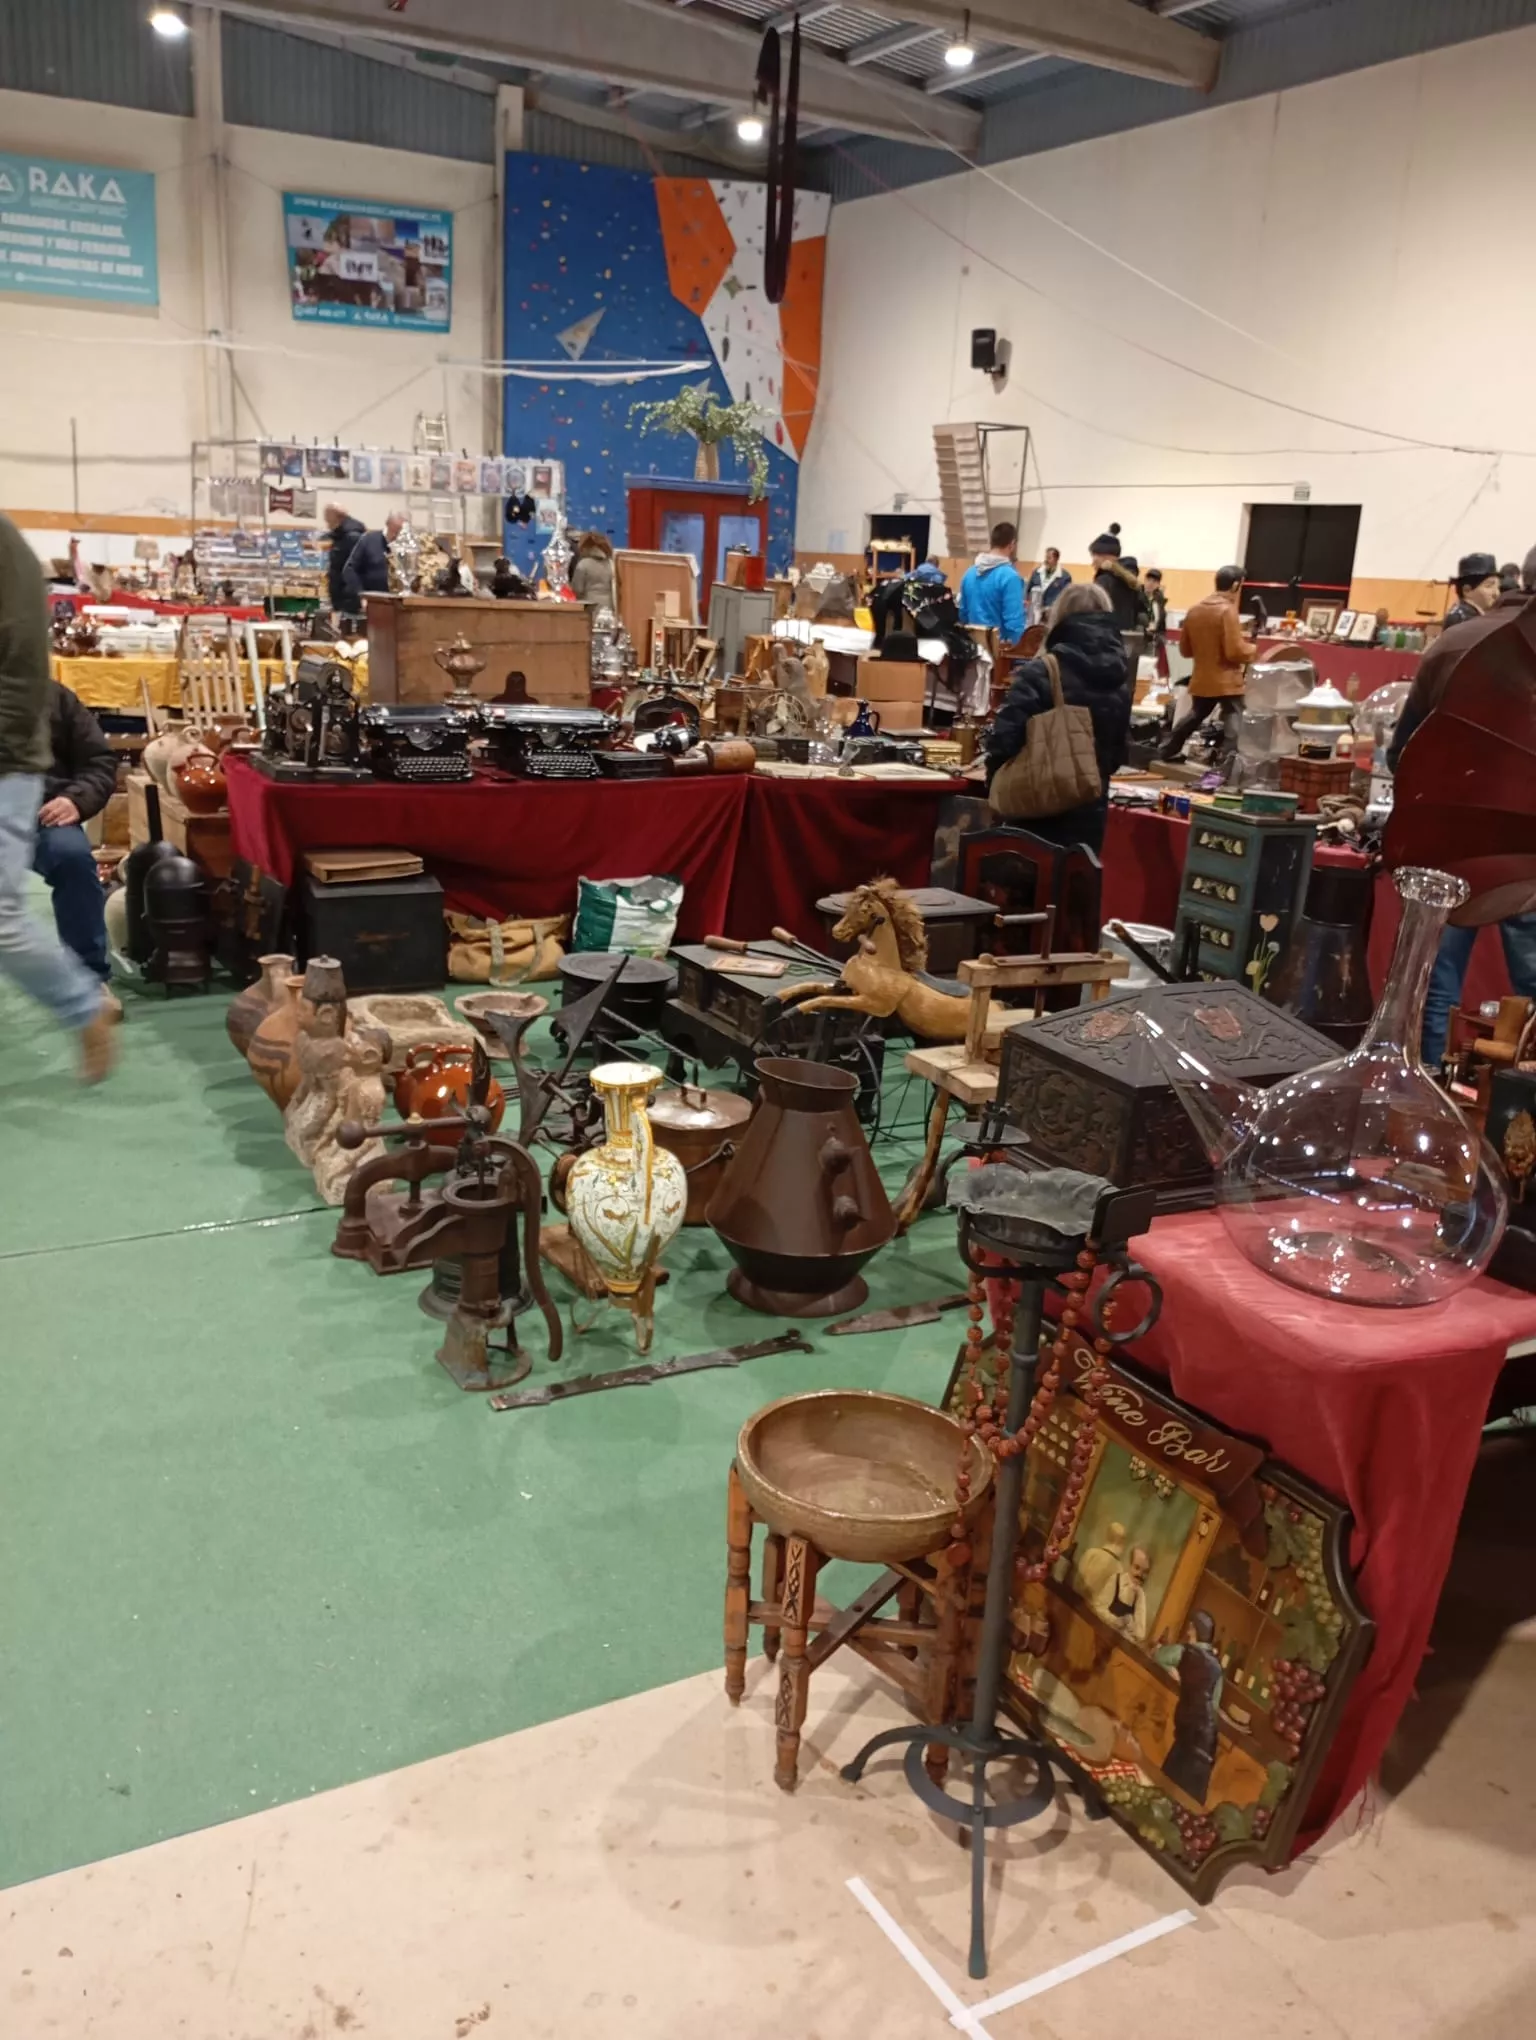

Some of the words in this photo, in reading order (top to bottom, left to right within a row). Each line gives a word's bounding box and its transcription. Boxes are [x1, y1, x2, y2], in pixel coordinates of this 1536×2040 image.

[28, 165, 127, 204] RAKA
[1072, 1347, 1149, 1427] Wine
[1147, 1420, 1232, 1474] Bar
